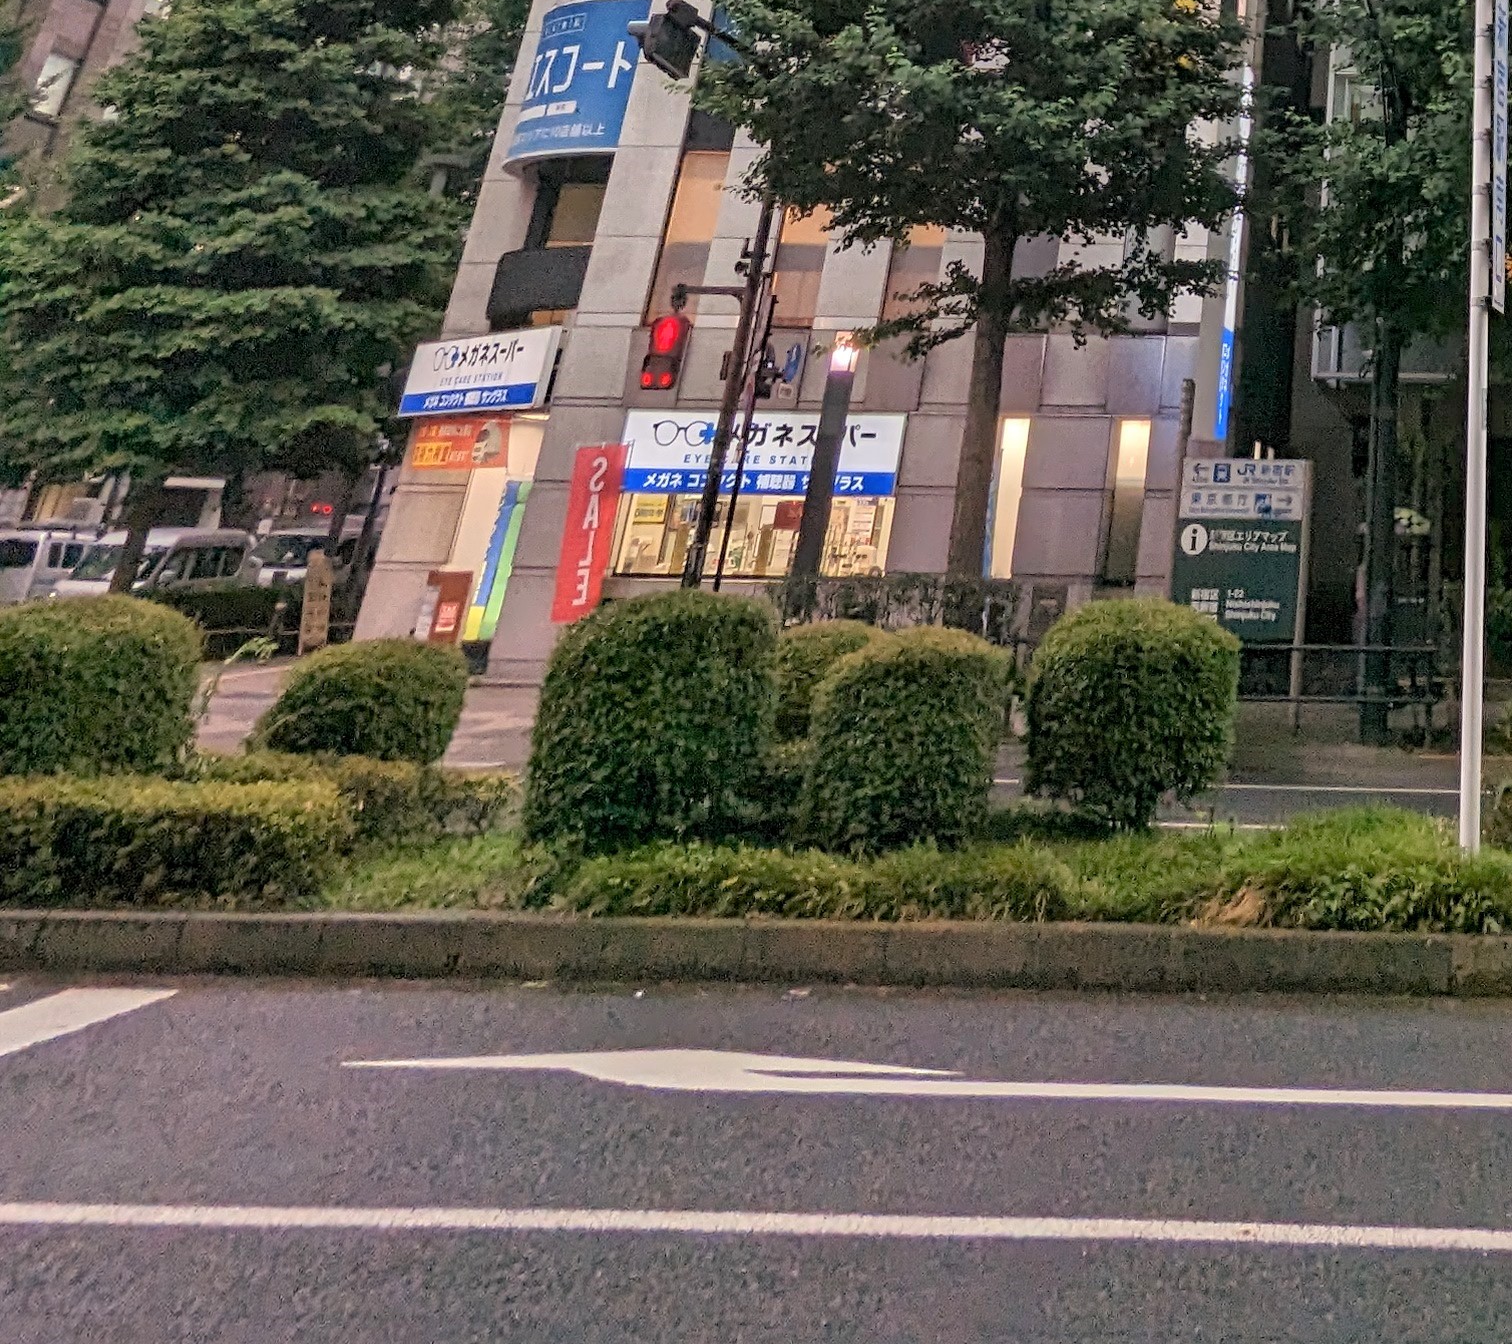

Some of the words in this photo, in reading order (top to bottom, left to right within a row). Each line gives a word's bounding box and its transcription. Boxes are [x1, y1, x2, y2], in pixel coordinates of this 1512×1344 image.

[457, 339, 524, 368] メガネスーパー
[642, 473, 682, 488] メガネ
